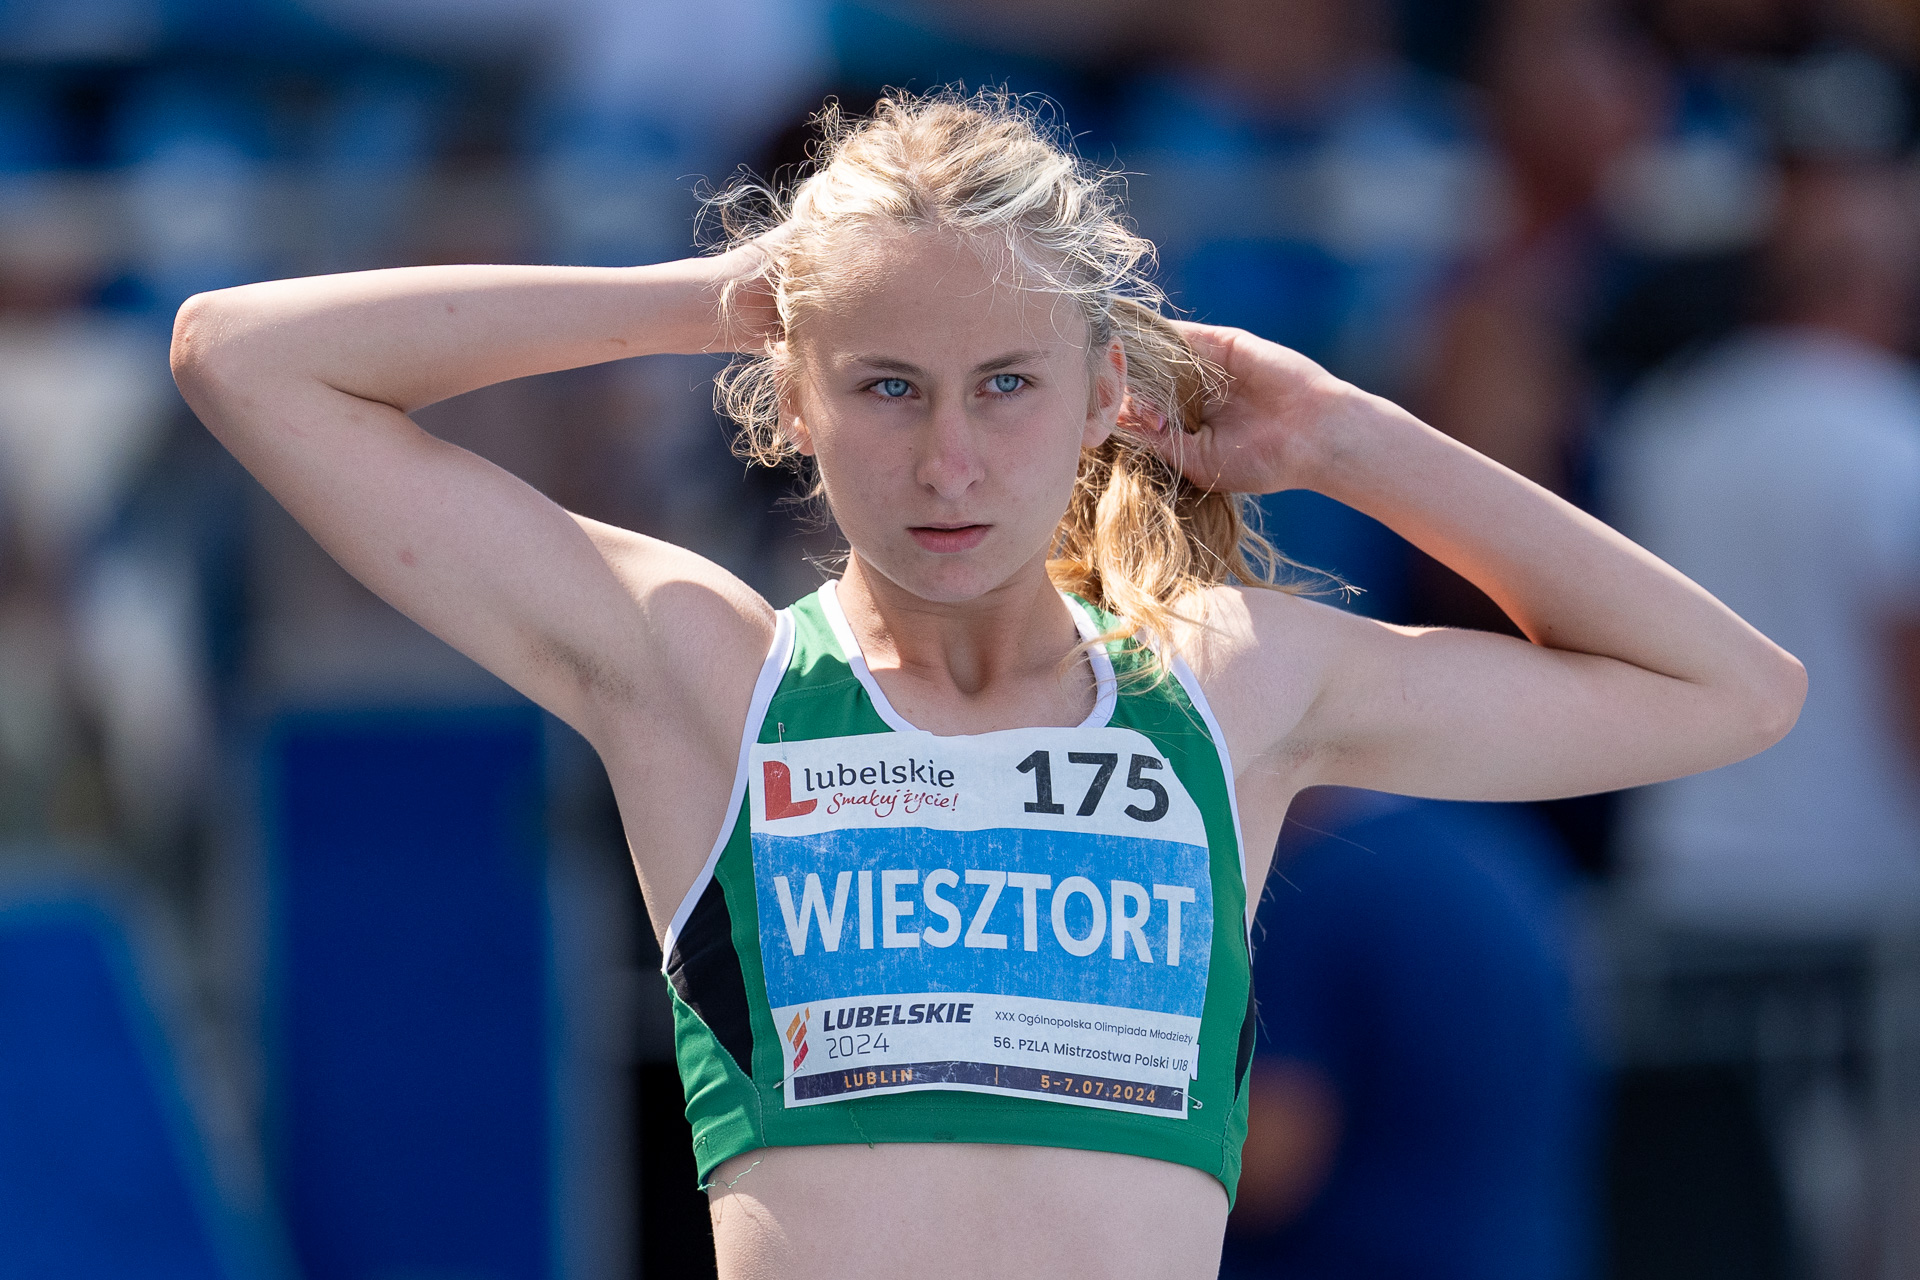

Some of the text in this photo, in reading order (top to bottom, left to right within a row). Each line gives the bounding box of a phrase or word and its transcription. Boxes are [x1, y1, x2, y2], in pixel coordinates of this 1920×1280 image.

[804, 758, 955, 792] lubelskie
[1015, 749, 1170, 822] 175
[827, 789, 959, 818] Smakuj życie!
[772, 868, 1196, 967] WIESZTORT
[823, 1003, 974, 1032] LUBELSKIE
[994, 1011, 1194, 1046] XXX Ogólnopolska Olimpiada Młodzieży
[826, 1032, 890, 1059] 2024
[993, 1036, 1189, 1072] 56. PZLA Mistrzostwa Polski U18
[844, 1069, 913, 1089] LUBLIN
[1040, 1074, 1156, 1104] 5-7.07.2024
